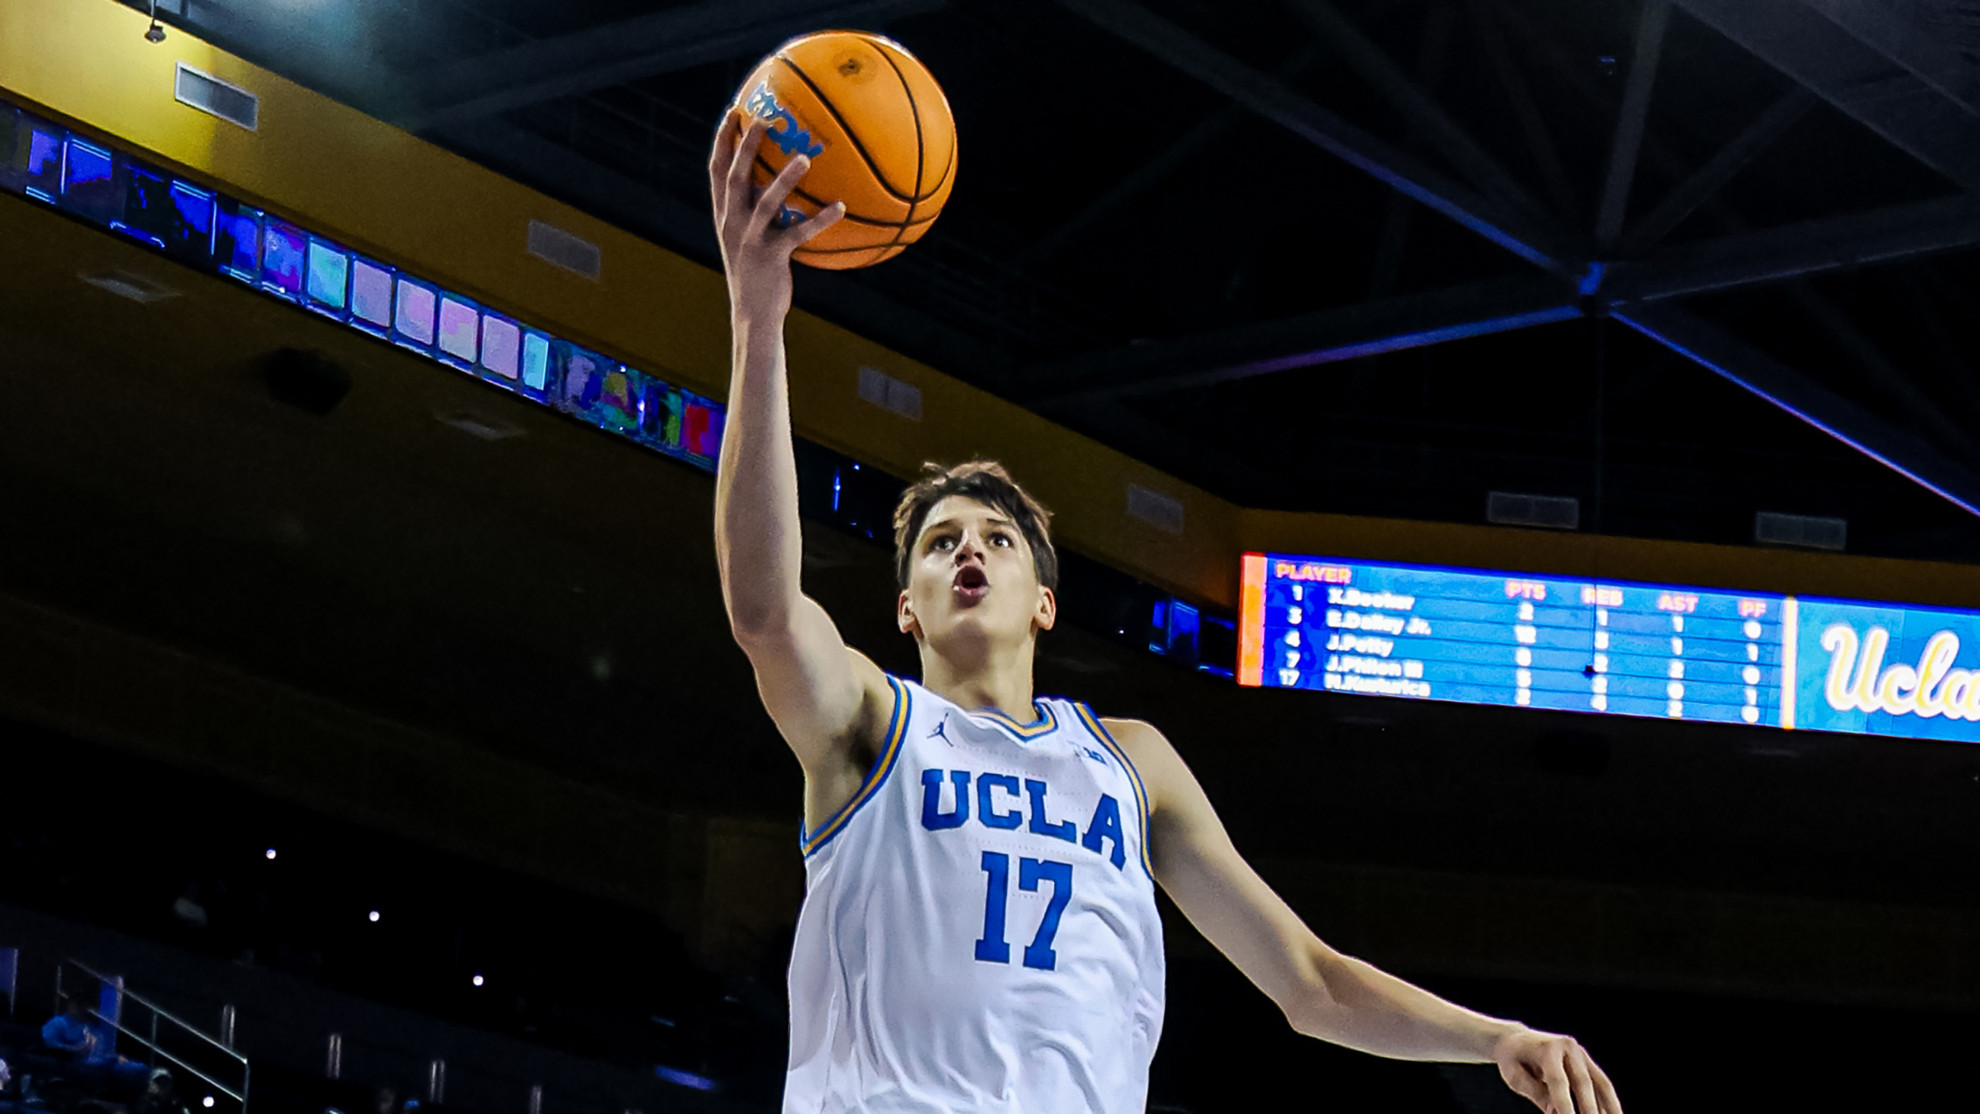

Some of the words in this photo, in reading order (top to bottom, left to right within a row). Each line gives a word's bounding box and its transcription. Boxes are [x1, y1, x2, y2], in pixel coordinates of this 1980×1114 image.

[1276, 562, 1351, 584] PLAYER
[1506, 581, 1546, 600] PTS
[1582, 587, 1623, 607] REB
[1658, 594, 1699, 612] AST
[1739, 601, 1767, 618] PF
[1293, 585, 1303, 601] 1
[1288, 607, 1302, 624] 3
[1406, 616, 1432, 636] Jr.
[1285, 631, 1300, 647] 4
[1287, 651, 1300, 668] 7
[1279, 668, 1300, 685] 17
[921, 769, 1126, 871] UCLA
[974, 851, 1073, 971] 17
